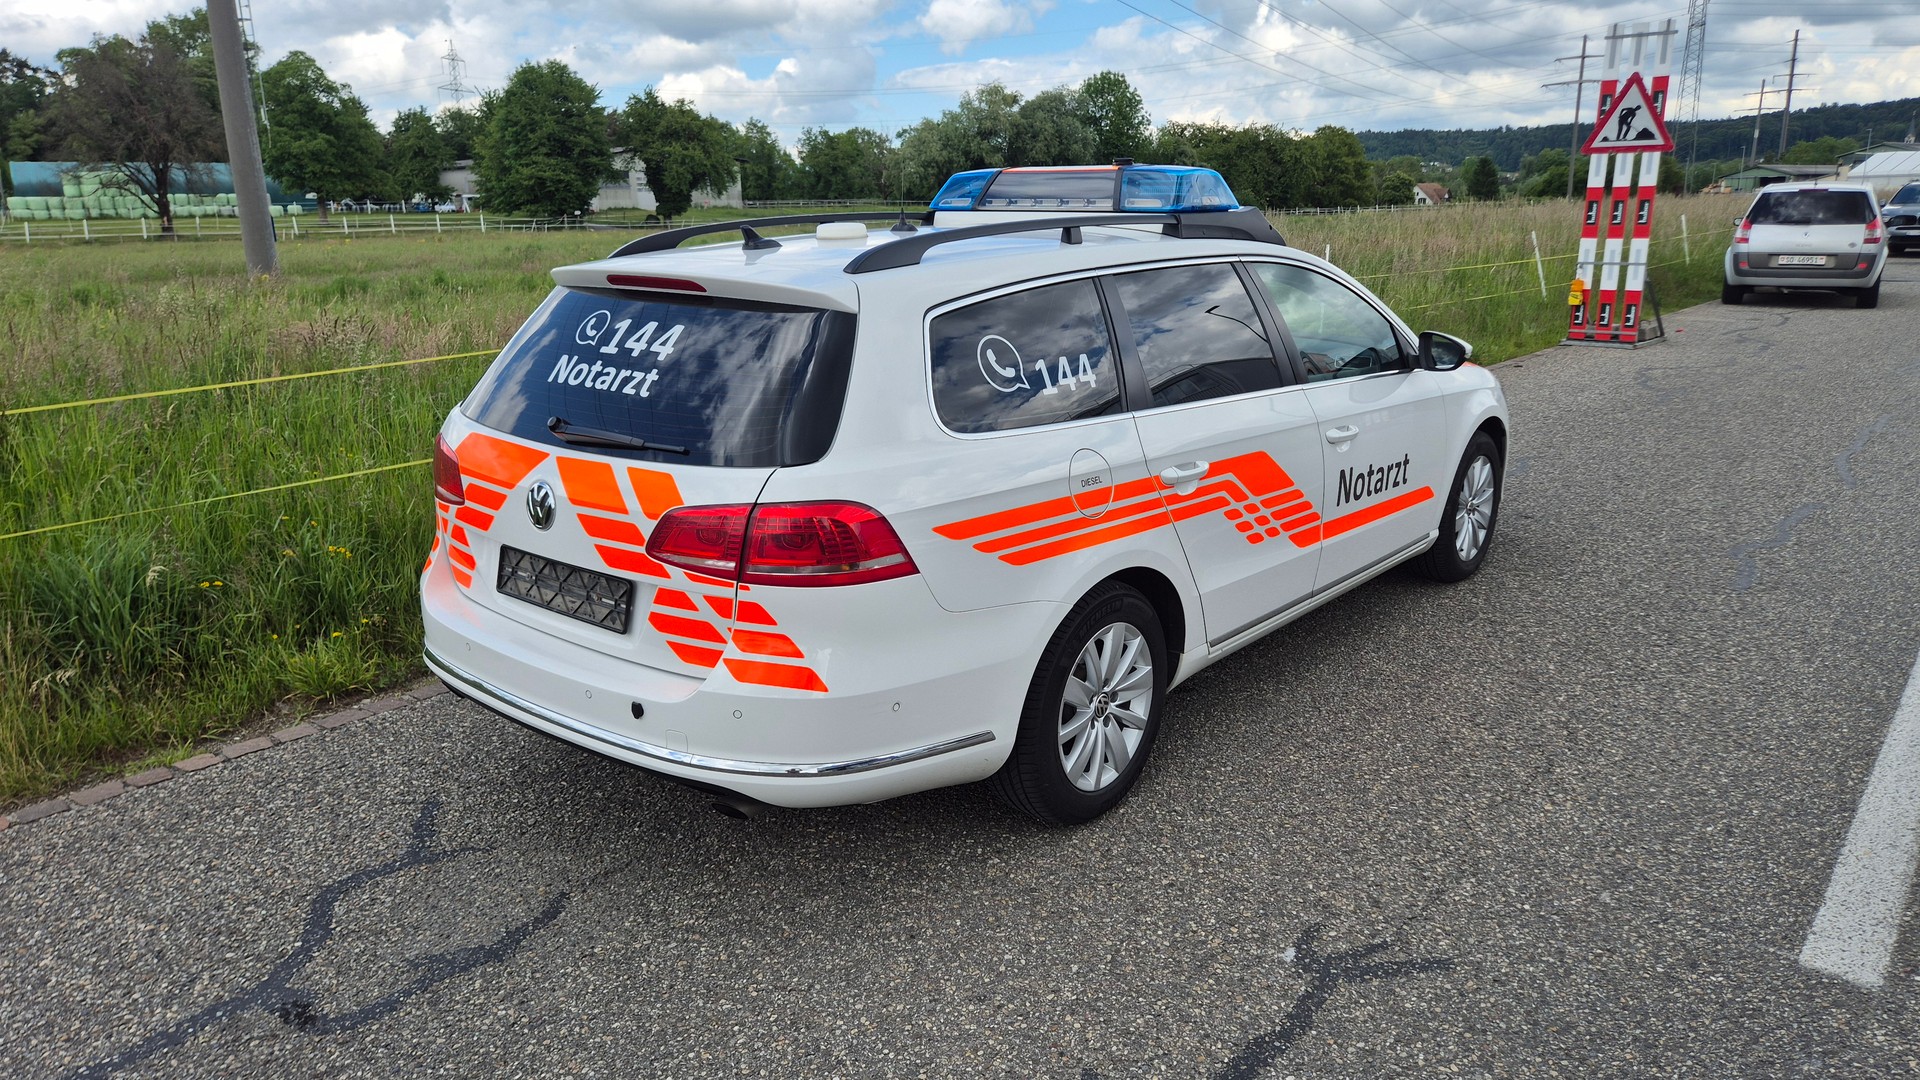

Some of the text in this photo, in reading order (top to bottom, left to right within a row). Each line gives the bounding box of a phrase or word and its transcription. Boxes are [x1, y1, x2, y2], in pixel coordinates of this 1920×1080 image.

[600, 319, 685, 360] 144
[547, 355, 659, 397] Notarzt
[1035, 354, 1096, 395] 144
[1081, 476, 1103, 487] DIESEL
[1337, 453, 1409, 507] Notarzt
